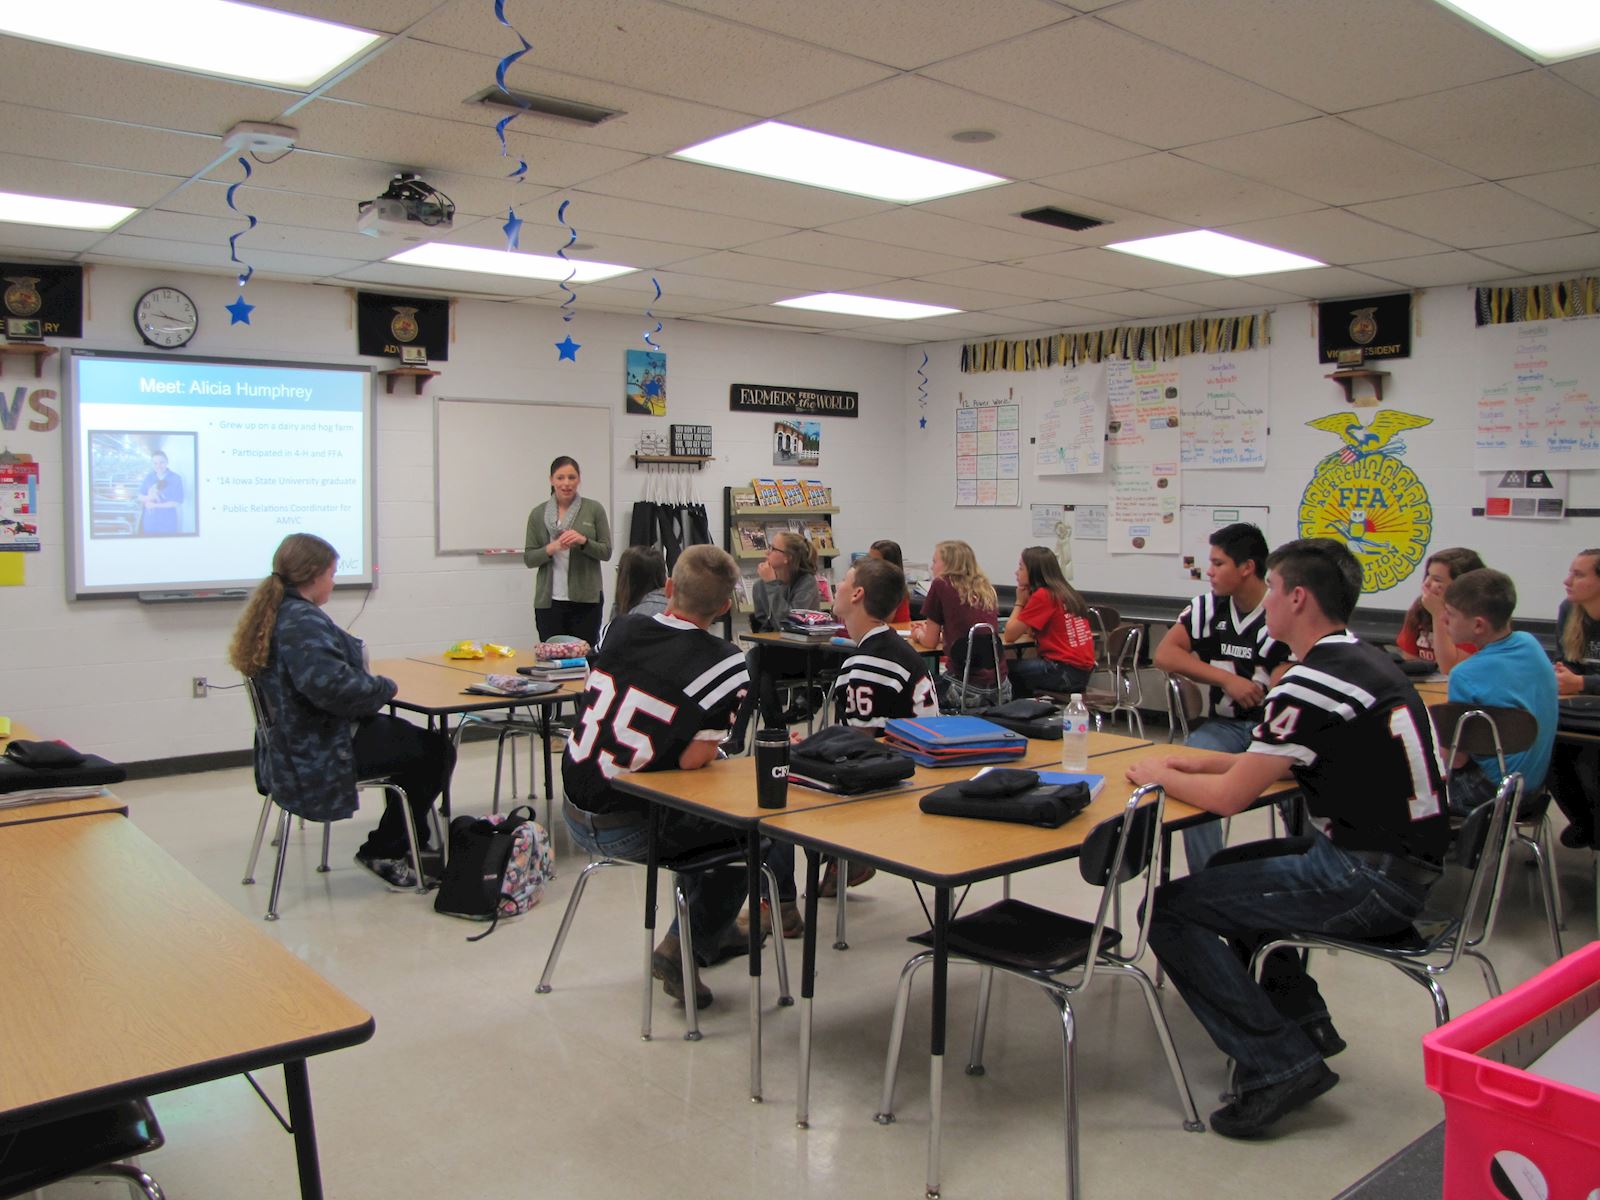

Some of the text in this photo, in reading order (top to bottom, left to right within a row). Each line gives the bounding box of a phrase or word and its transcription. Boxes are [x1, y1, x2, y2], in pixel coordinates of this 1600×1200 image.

[140, 378, 312, 402] Meet: Alicia Humphrey
[740, 388, 795, 406] FARMERS
[816, 395, 855, 410] WORLD
[220, 420, 242, 429] Grew
[245, 423, 255, 431] up
[278, 422, 297, 432] dairy
[301, 423, 316, 431] and
[318, 423, 332, 432] hog
[232, 449, 283, 458] Participated
[311, 450, 326, 458] and
[232, 477, 252, 485] Iowa
[255, 477, 277, 485] State
[279, 477, 319, 486] University
[321, 477, 357, 487] graduate
[1318, 469, 1408, 512] AGRICULTURAL
[1338, 488, 1388, 508] FFA
[223, 504, 351, 512] Public Relations Coordinator for
[1220, 644, 1252, 659] RAIDERS
[567, 667, 679, 780] 35
